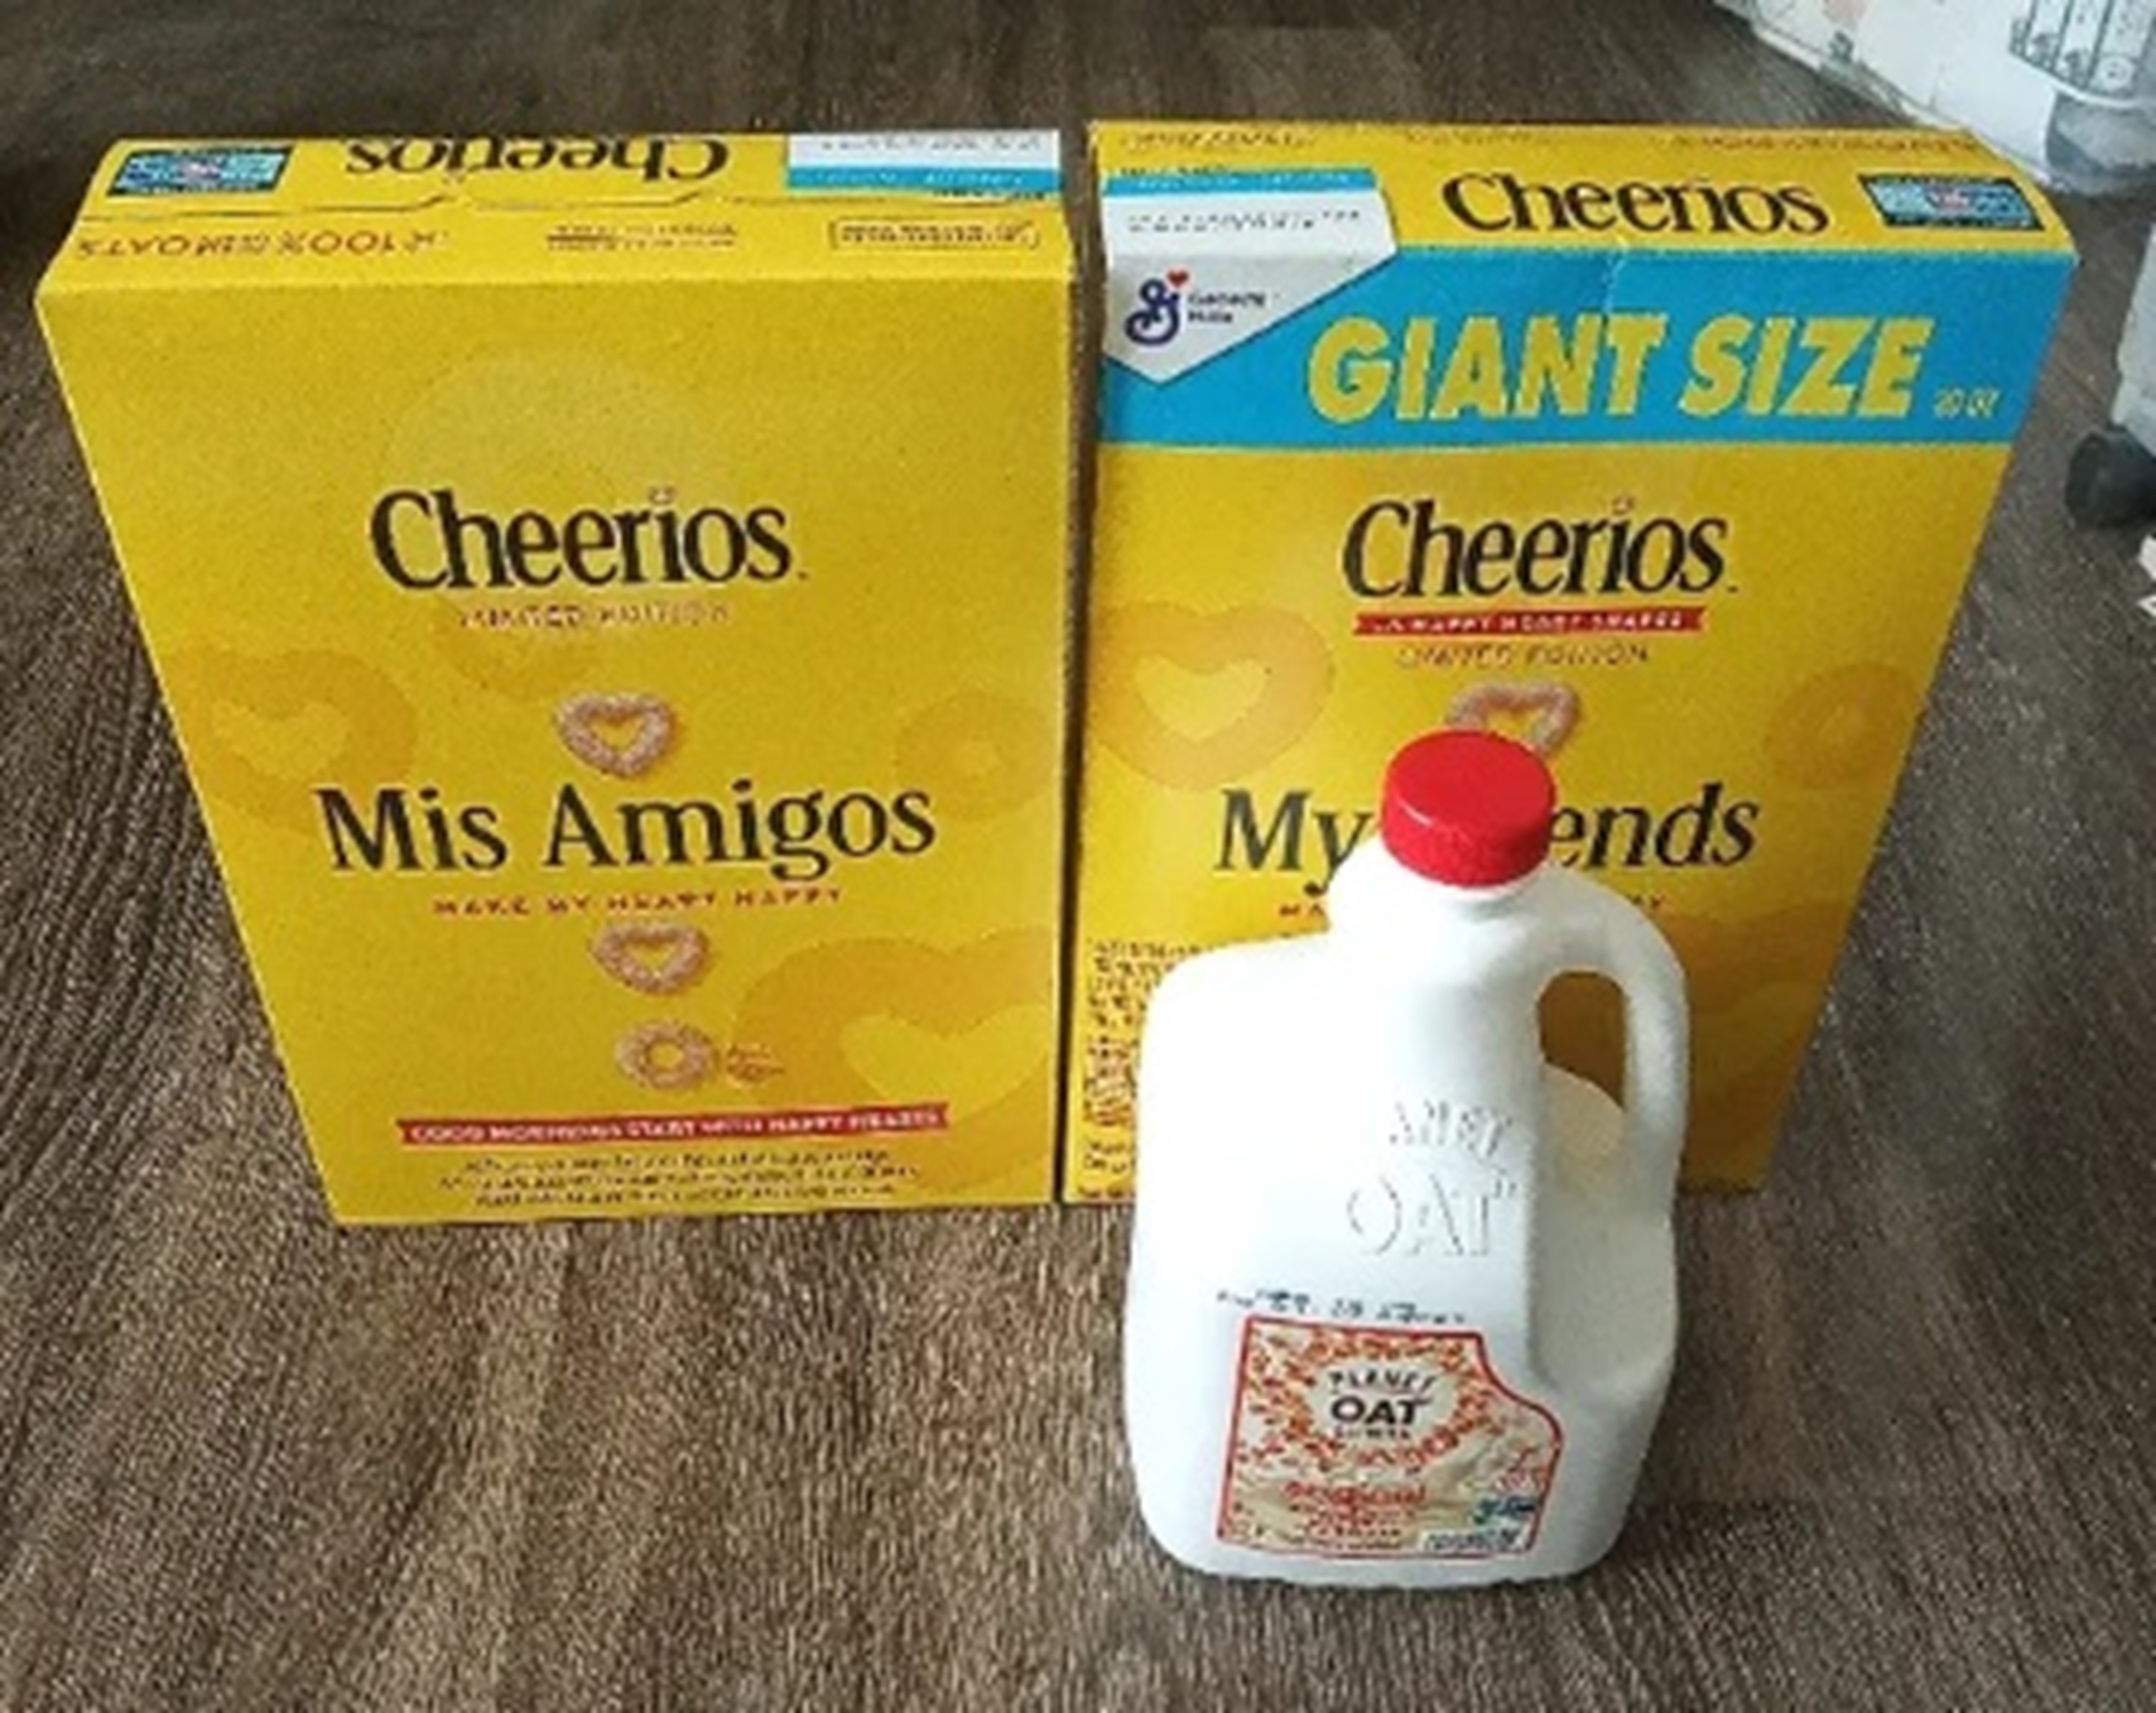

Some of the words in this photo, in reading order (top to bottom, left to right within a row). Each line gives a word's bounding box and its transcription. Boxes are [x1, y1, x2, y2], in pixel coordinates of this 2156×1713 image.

[1442, 173, 1830, 235] Cheerios
[1307, 312, 1667, 424] GIANT
[1676, 313, 1935, 418] SIZE
[370, 487, 792, 589] Cheerios
[1342, 496, 1728, 598] Cheerios
[311, 787, 508, 871] Mis
[542, 779, 937, 882] Amigos
[1215, 788, 1372, 896] My
[1330, 1395, 1432, 1425] OAT
